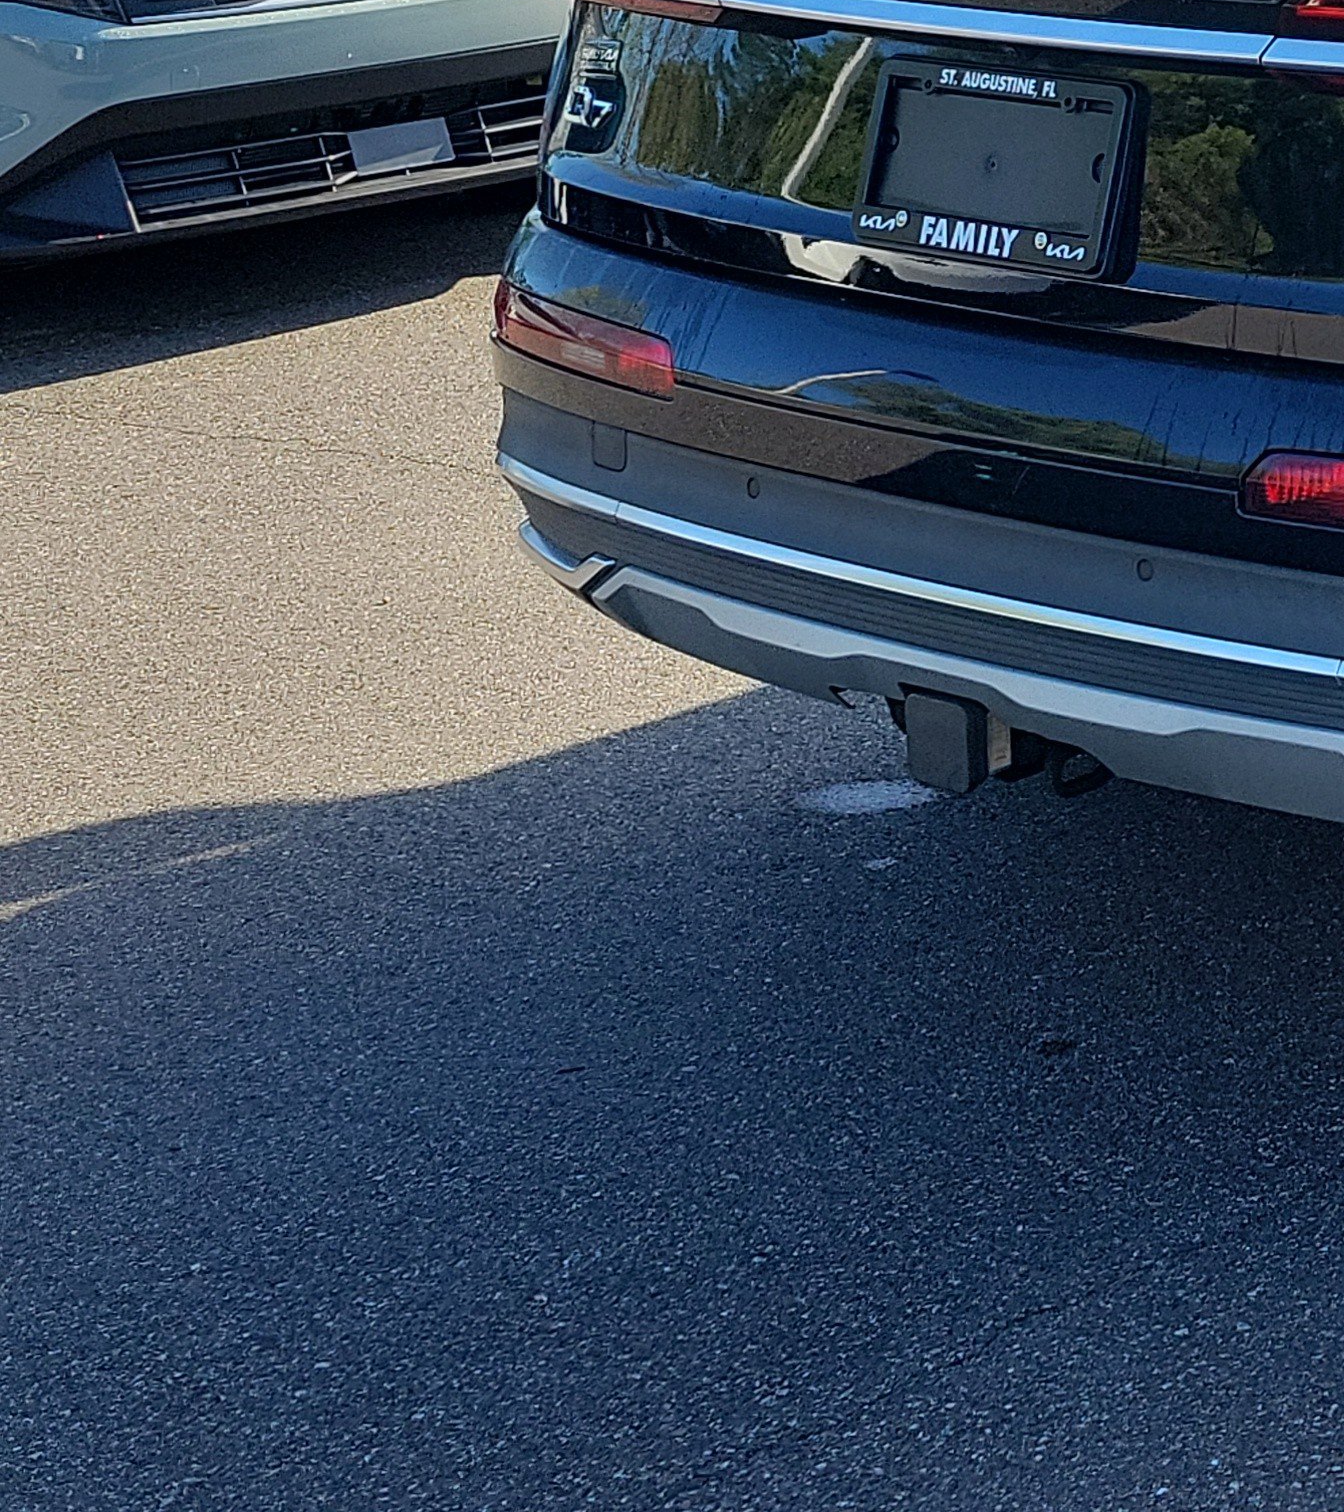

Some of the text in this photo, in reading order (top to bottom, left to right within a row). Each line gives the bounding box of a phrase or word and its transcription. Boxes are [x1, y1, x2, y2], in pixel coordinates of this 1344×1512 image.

[939, 68, 1056, 99] ST. AUGUSTINE, FL
[919, 215, 1019, 258] FAMILY
